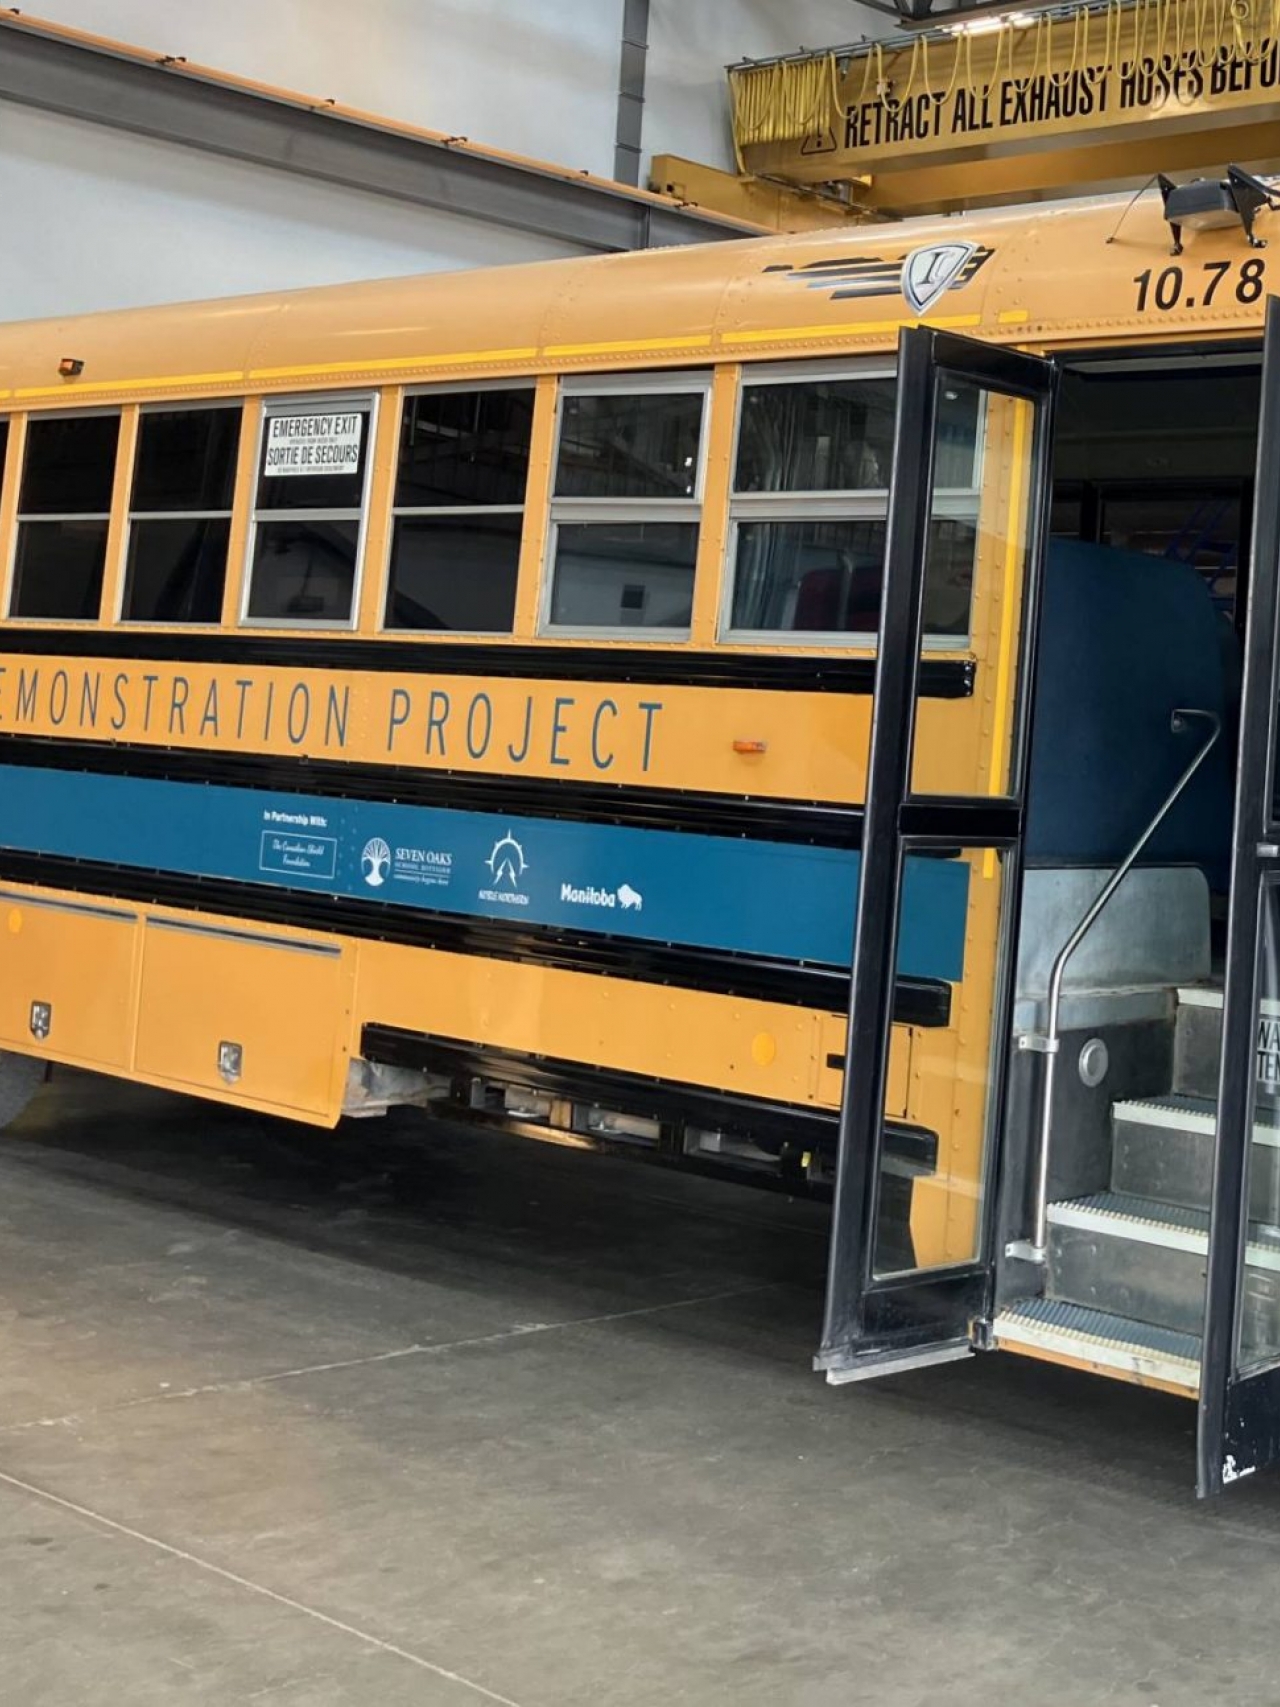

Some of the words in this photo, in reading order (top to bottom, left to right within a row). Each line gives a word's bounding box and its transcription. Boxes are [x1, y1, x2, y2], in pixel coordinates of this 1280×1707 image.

[845, 91, 946, 149] RETRACT
[951, 85, 993, 133] ALL
[1000, 65, 1113, 127] EXHAUST
[1120, 50, 1205, 109] HOSES
[1133, 258, 1266, 311] 10.78
[273, 417, 333, 438] EMERGENCY
[334, 415, 358, 435] EXIT
[268, 446, 300, 466] SORTIE
[301, 445, 314, 464] DE
[315, 444, 358, 463] SECOURS
[0, 667, 350, 748] MONSTRATION
[387, 688, 664, 773] PROJECT
[395, 848, 425, 862] SEVEN
[427, 851, 452, 866] OAKS
[560, 883, 616, 908] Manitoba
